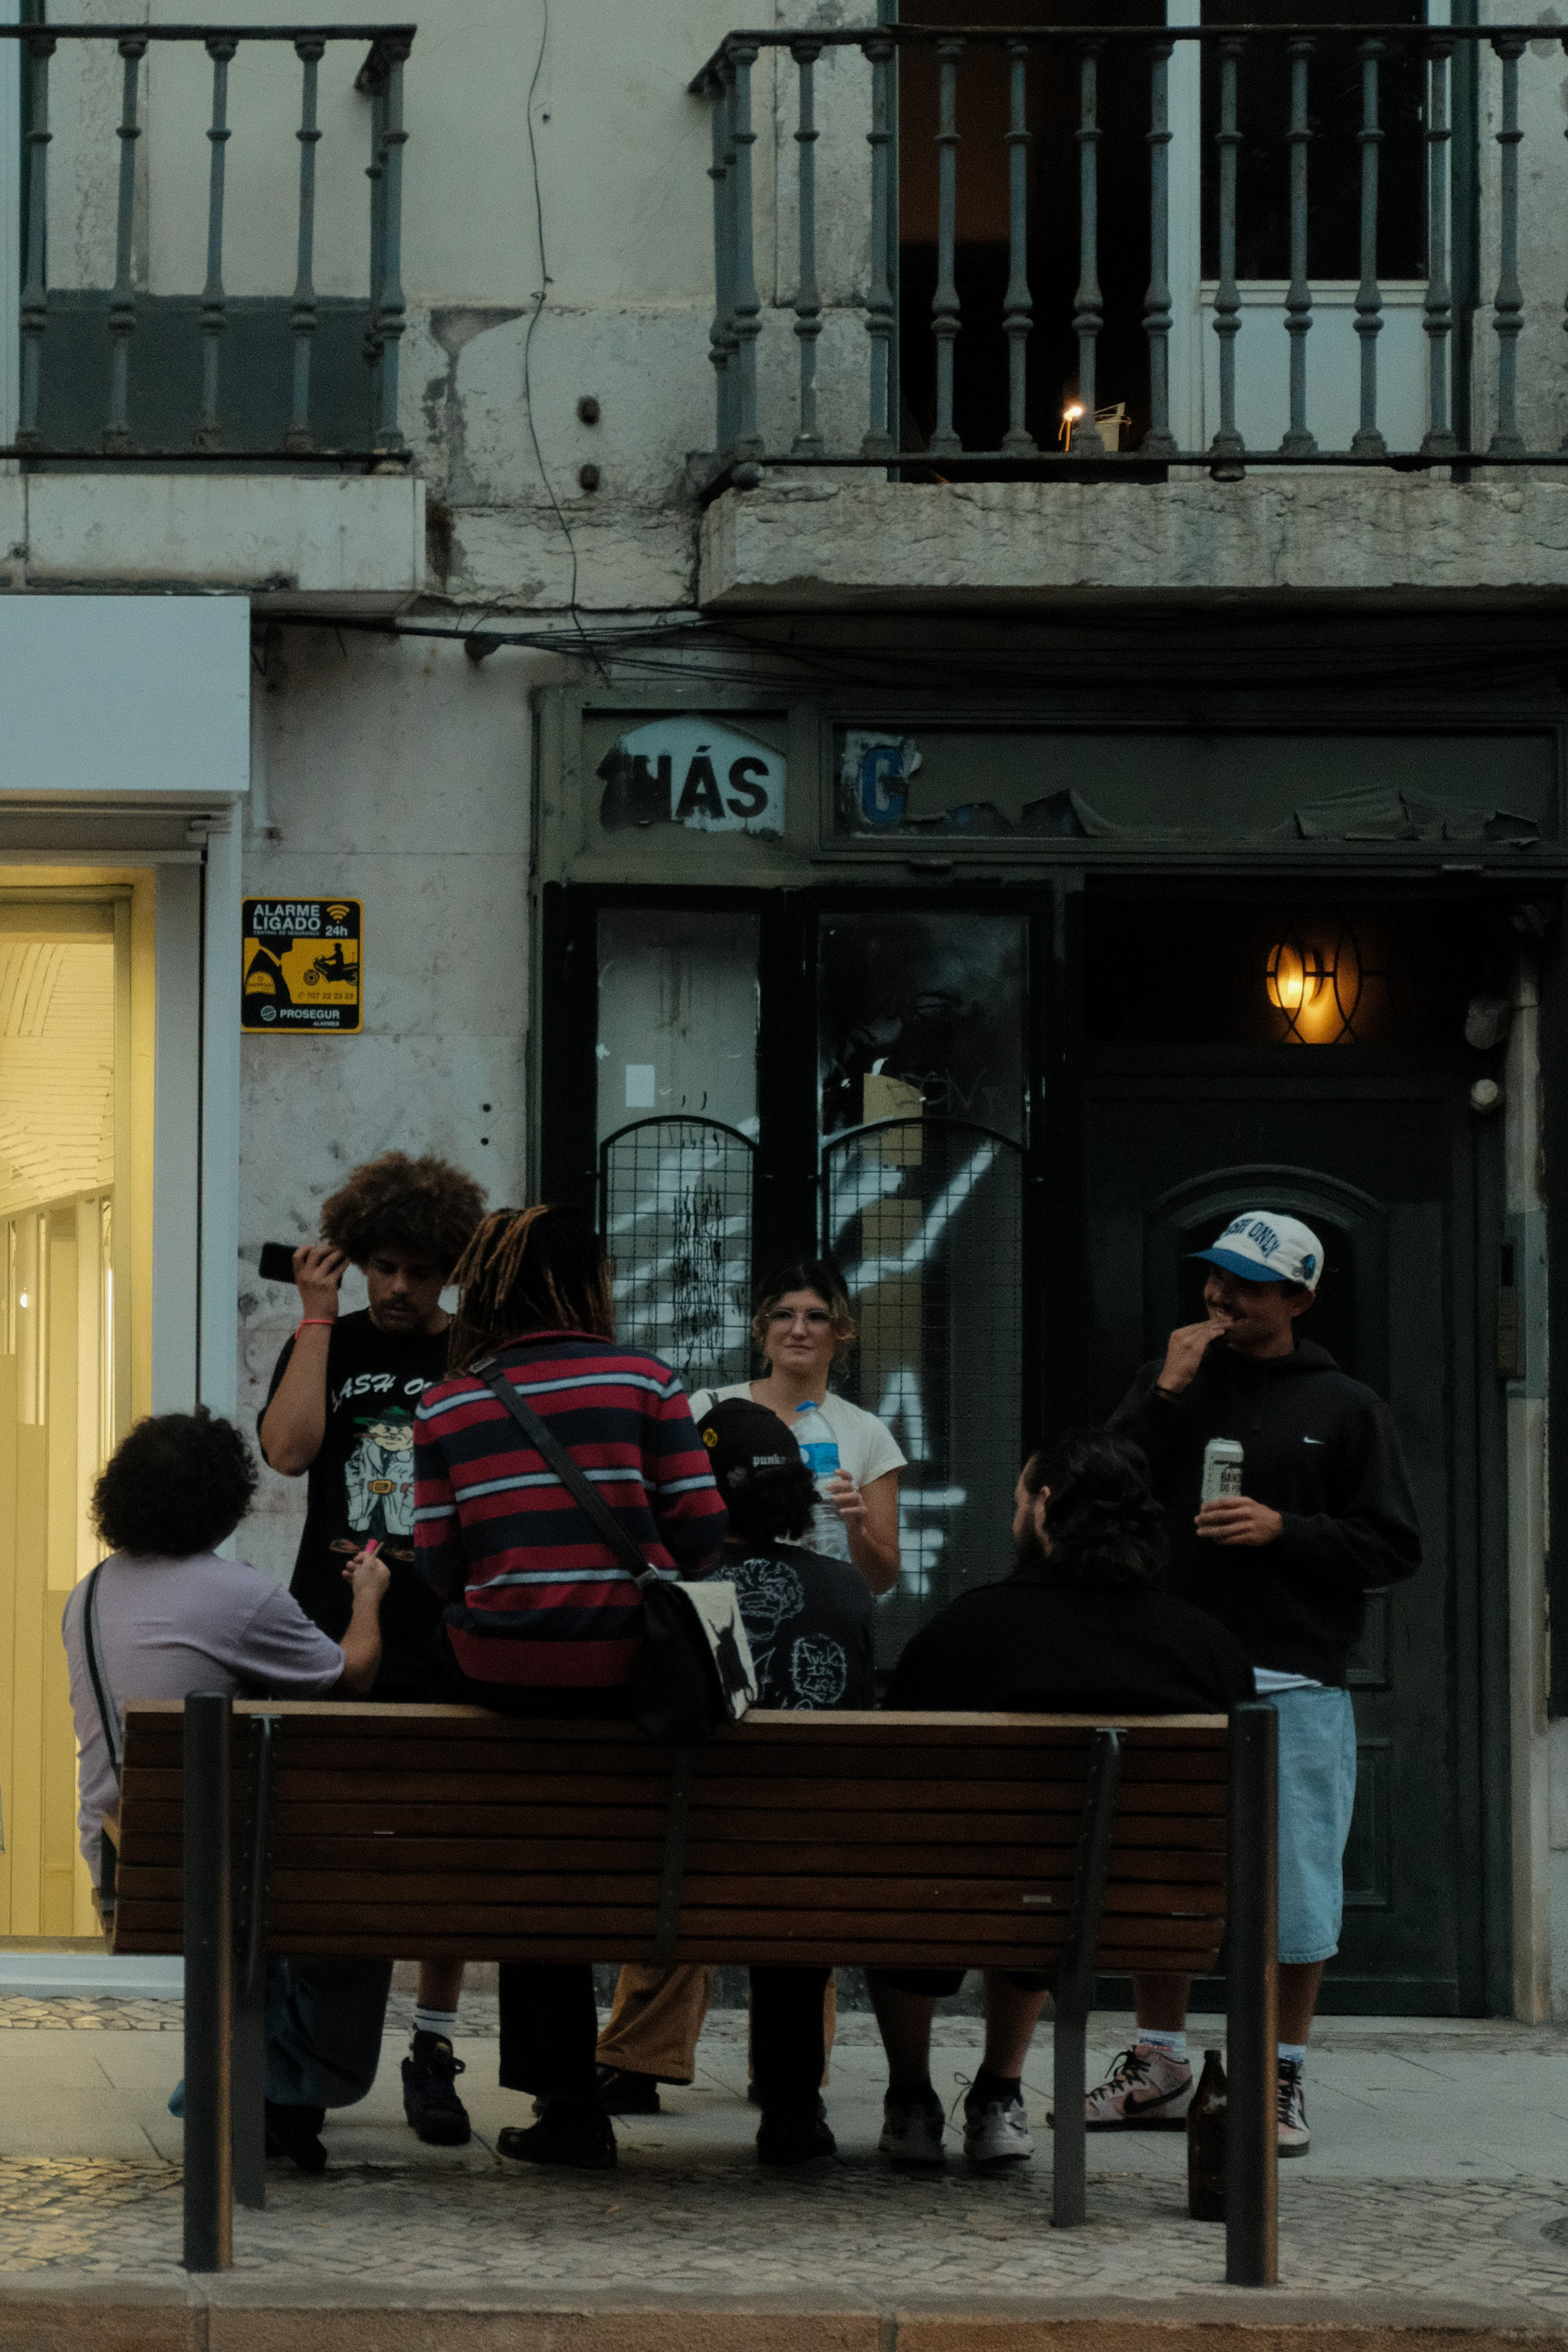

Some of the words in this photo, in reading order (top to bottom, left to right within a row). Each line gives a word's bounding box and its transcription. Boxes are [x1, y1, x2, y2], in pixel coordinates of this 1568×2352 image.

[254, 904, 320, 916] ALARME
[253, 917, 321, 930] LIGADO
[325, 925, 348, 937] 24h
[280, 1009, 339, 1019] PROSEGUR
[1249, 1222, 1280, 1258] ONLY
